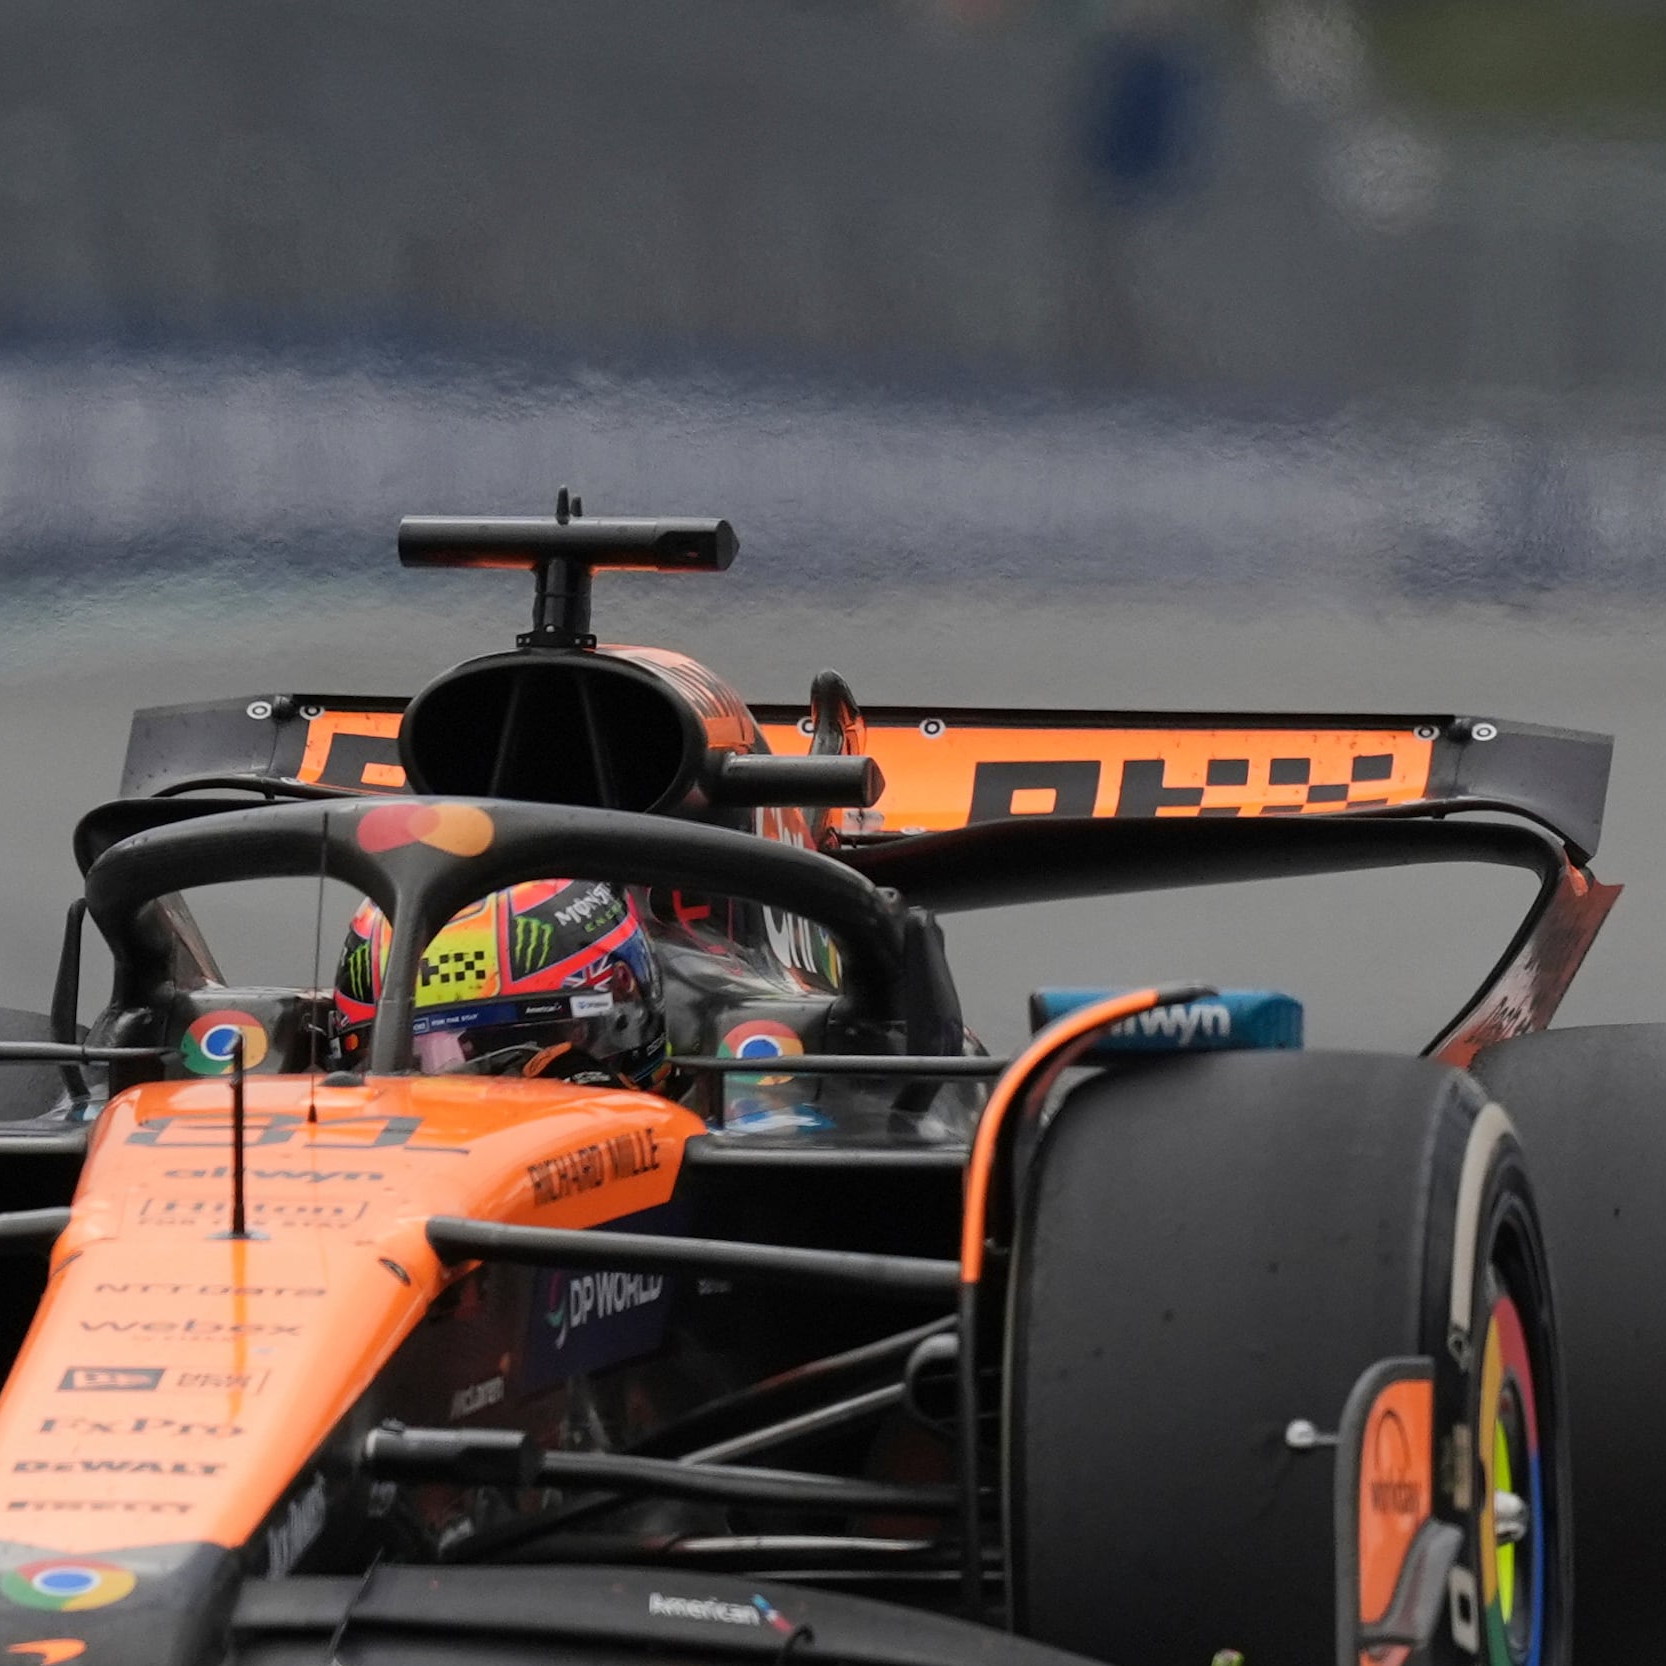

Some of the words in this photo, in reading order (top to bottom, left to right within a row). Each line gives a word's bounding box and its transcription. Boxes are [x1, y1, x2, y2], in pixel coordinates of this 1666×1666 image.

[554, 881, 614, 927] MONST
[420, 950, 486, 987] KX
[164, 1166, 385, 1183] alwyn
[527, 1144, 606, 1206] RICHARD
[607, 1127, 660, 1180] MILLE
[163, 1200, 345, 1217] Hiton
[569, 1275, 595, 1329] DP
[595, 1271, 664, 1319] WORLD
[80, 1317, 305, 1337] webex
[38, 1415, 246, 1437] FxPro
[648, 1591, 761, 1627] American
